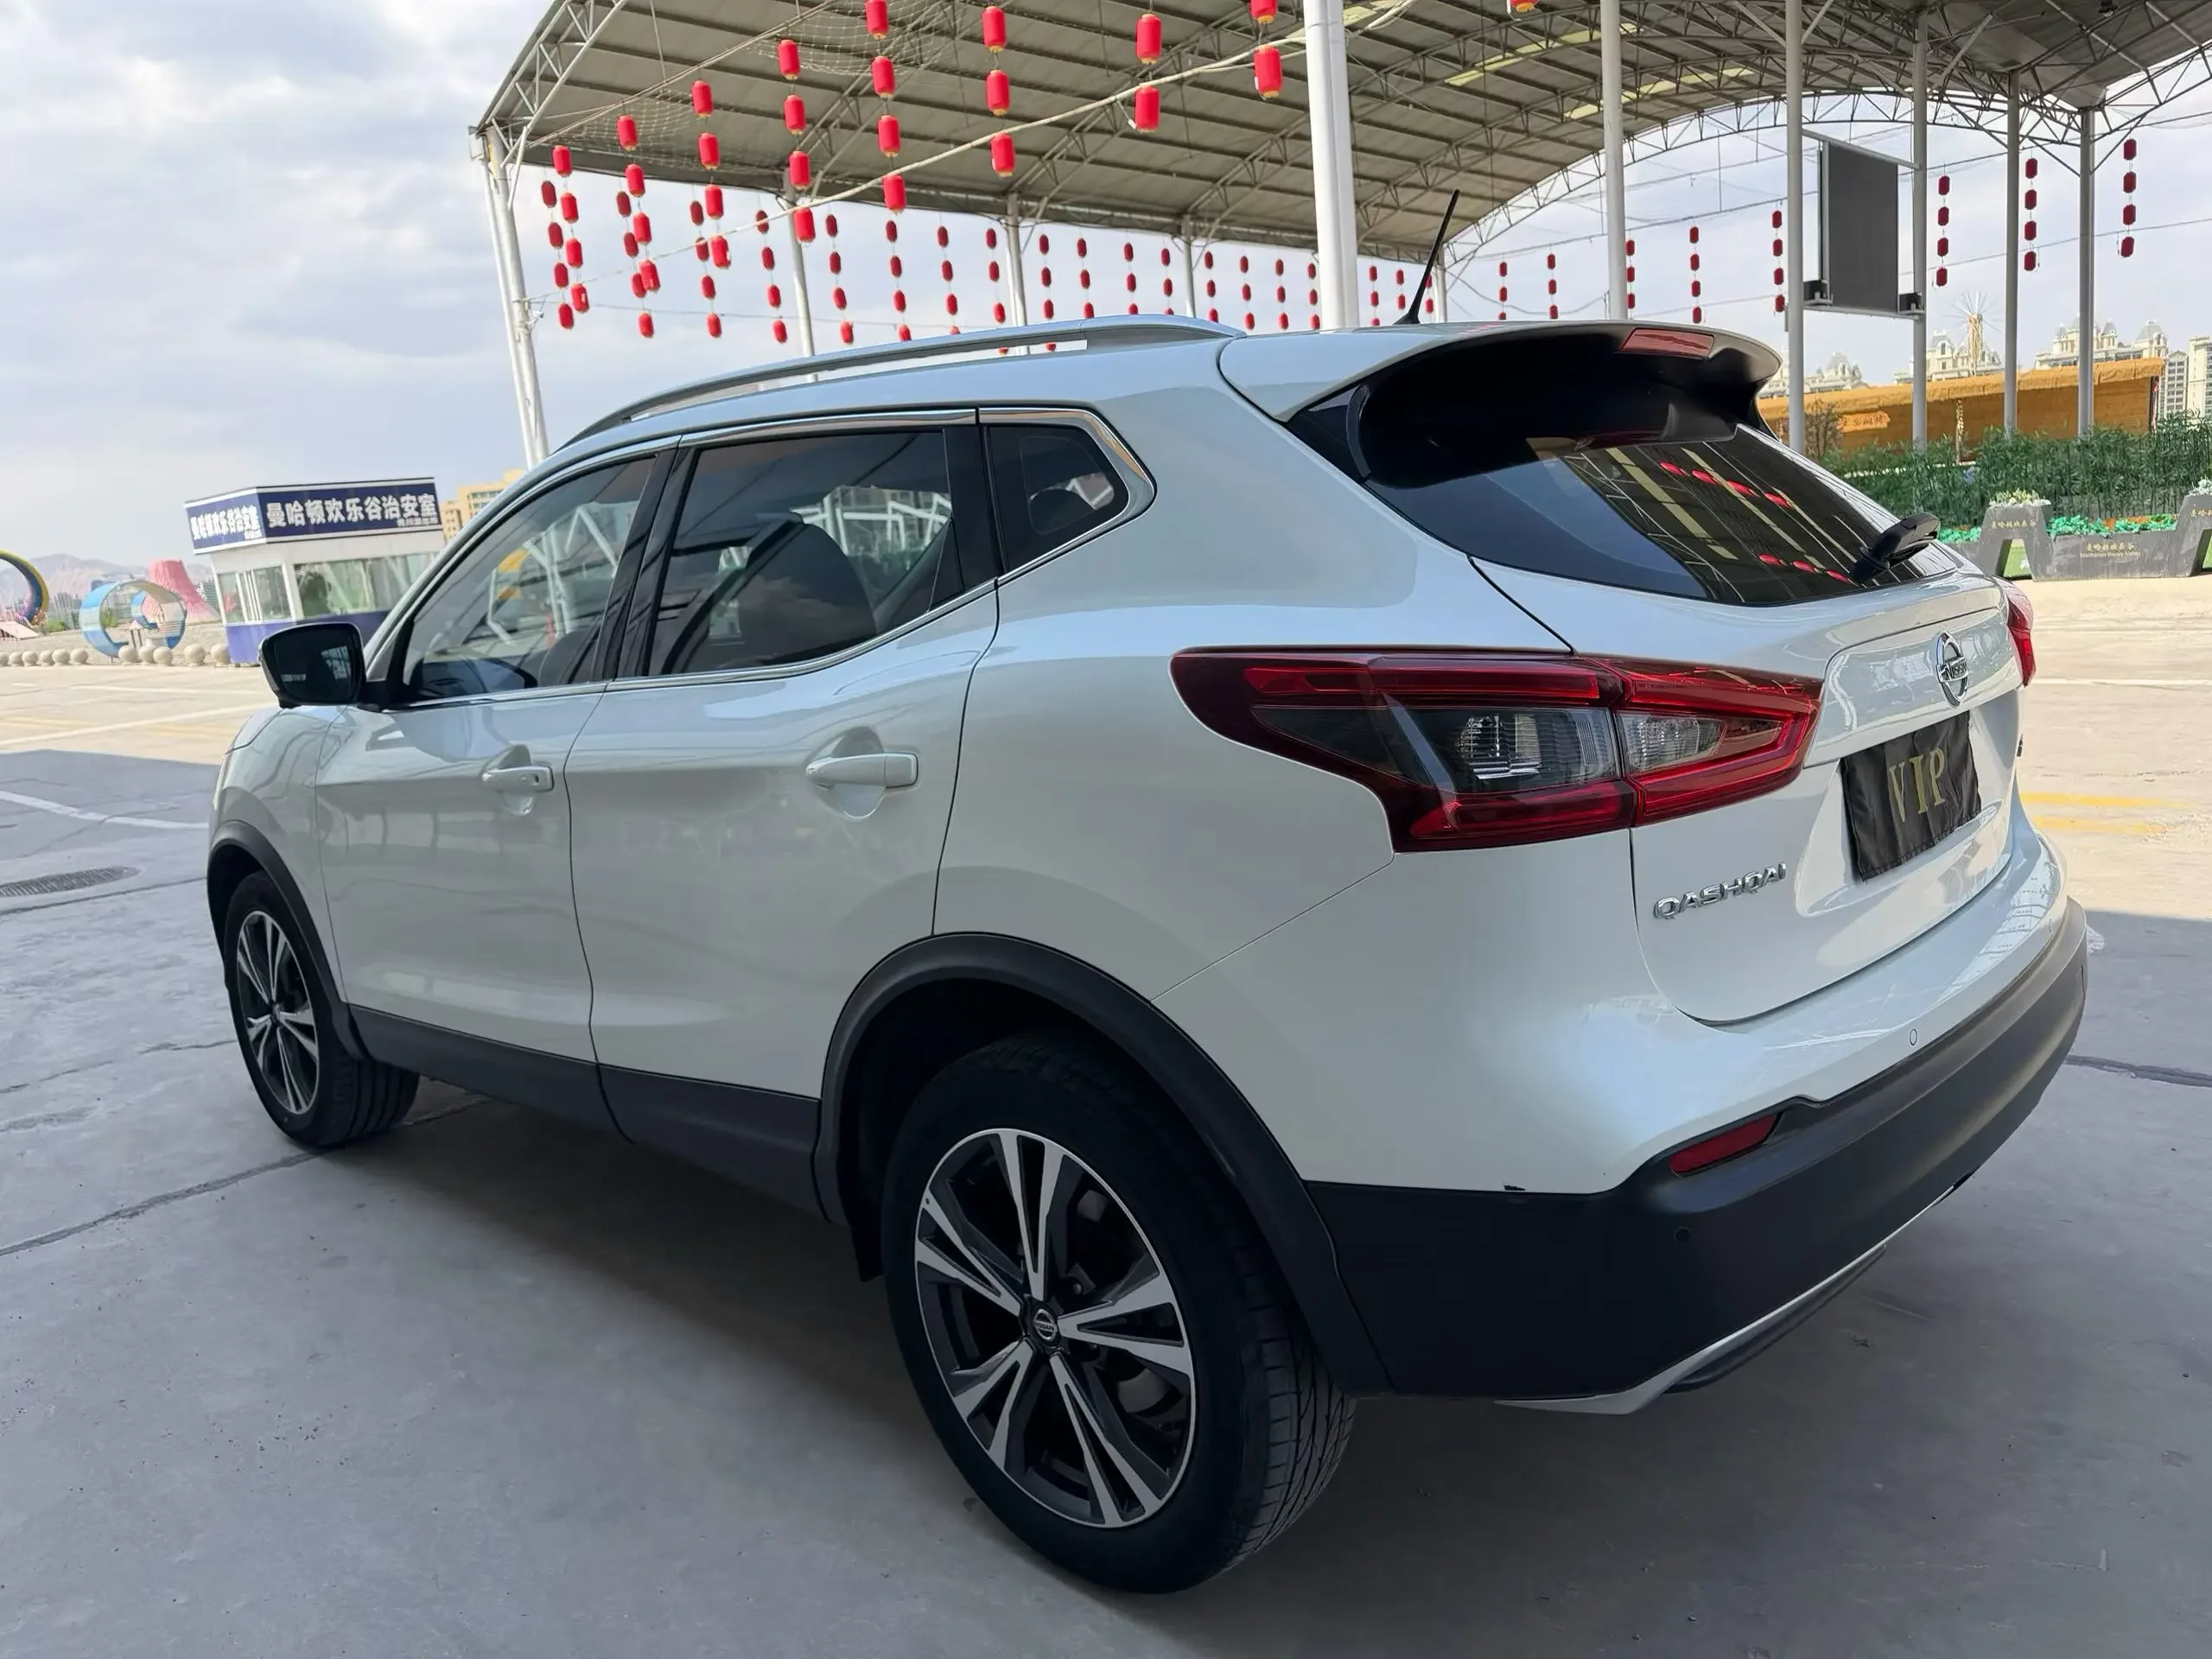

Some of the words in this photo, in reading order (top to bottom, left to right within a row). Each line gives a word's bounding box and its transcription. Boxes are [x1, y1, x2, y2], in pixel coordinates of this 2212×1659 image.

[266, 493, 436, 528] 曼哈顿欢乐谷治安室
[1889, 747, 1945, 823] VIP
[1653, 861, 1787, 919] QASHQAI
